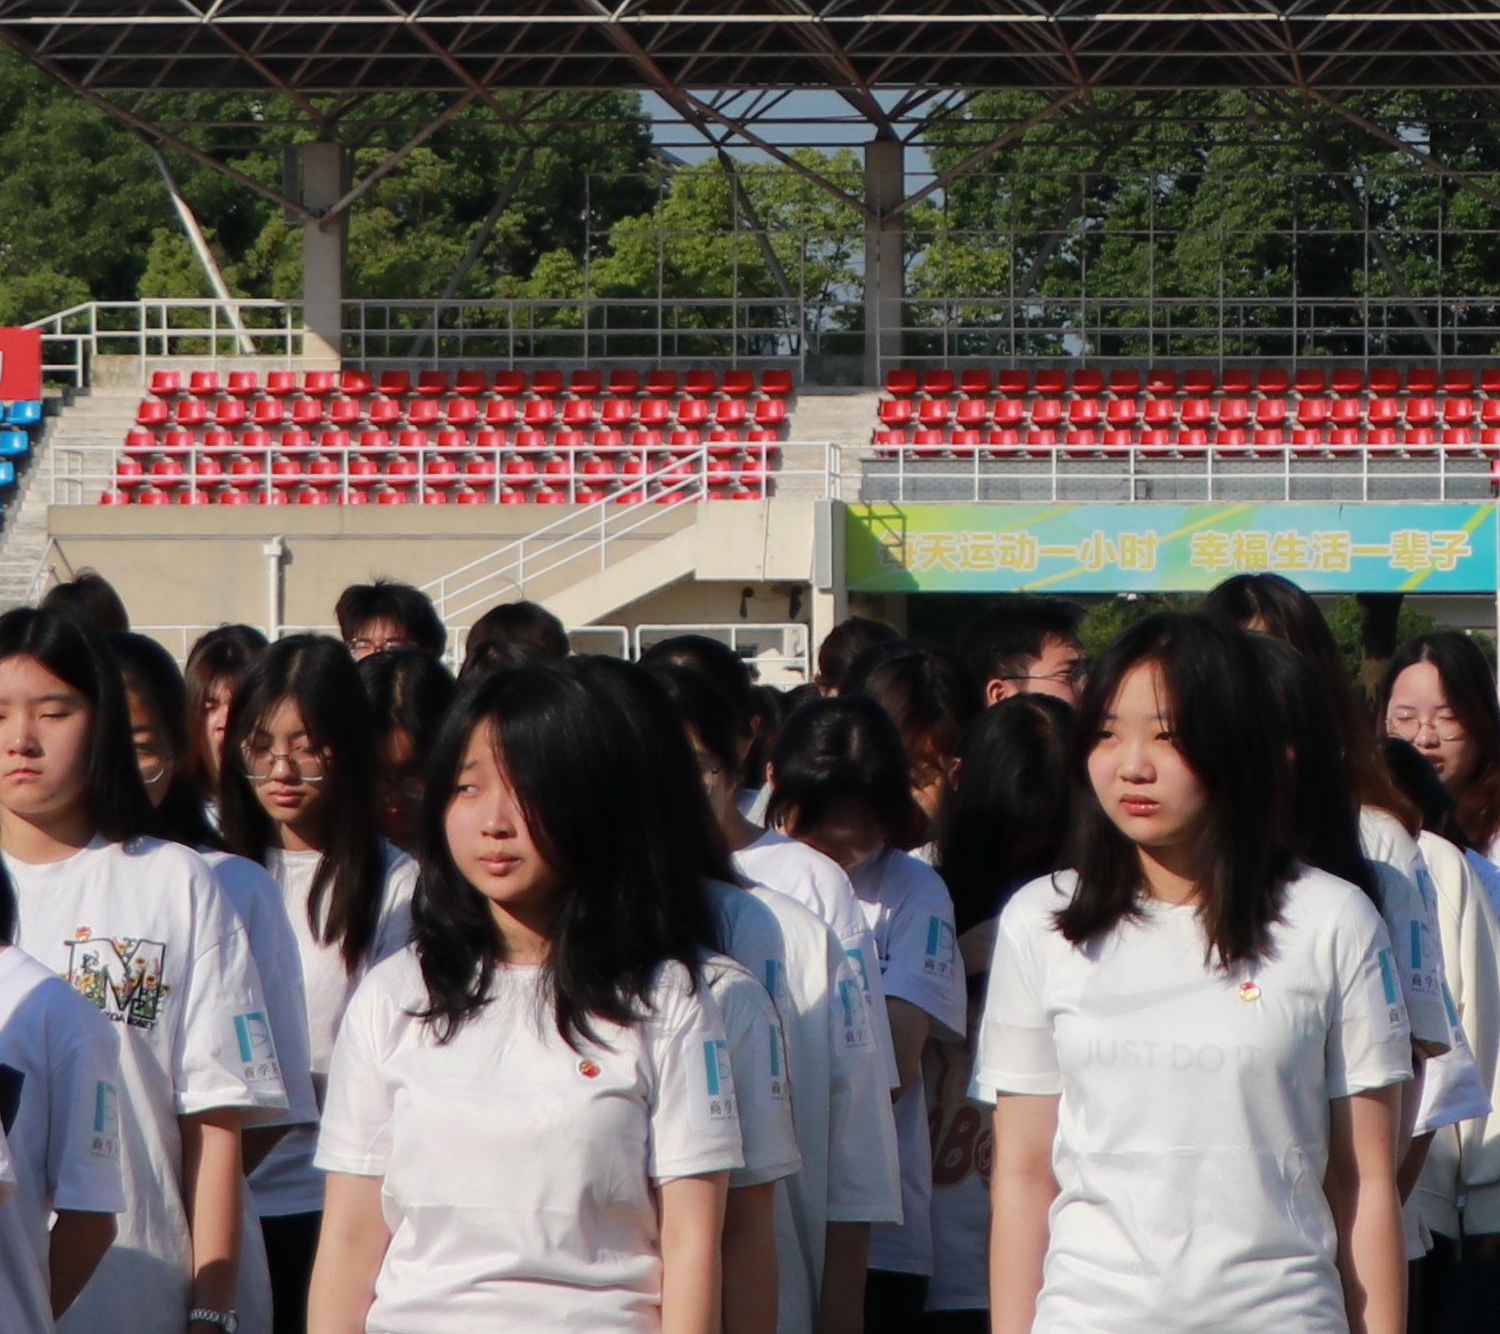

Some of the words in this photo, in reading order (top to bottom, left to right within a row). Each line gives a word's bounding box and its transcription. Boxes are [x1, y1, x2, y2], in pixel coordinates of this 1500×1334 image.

[879, 530, 1158, 571] 每天运动一小时
[1191, 529, 1472, 571] 幸福生活一辈子
[1084, 1038, 1160, 1067] JUST
[1171, 1042, 1225, 1072] DO
